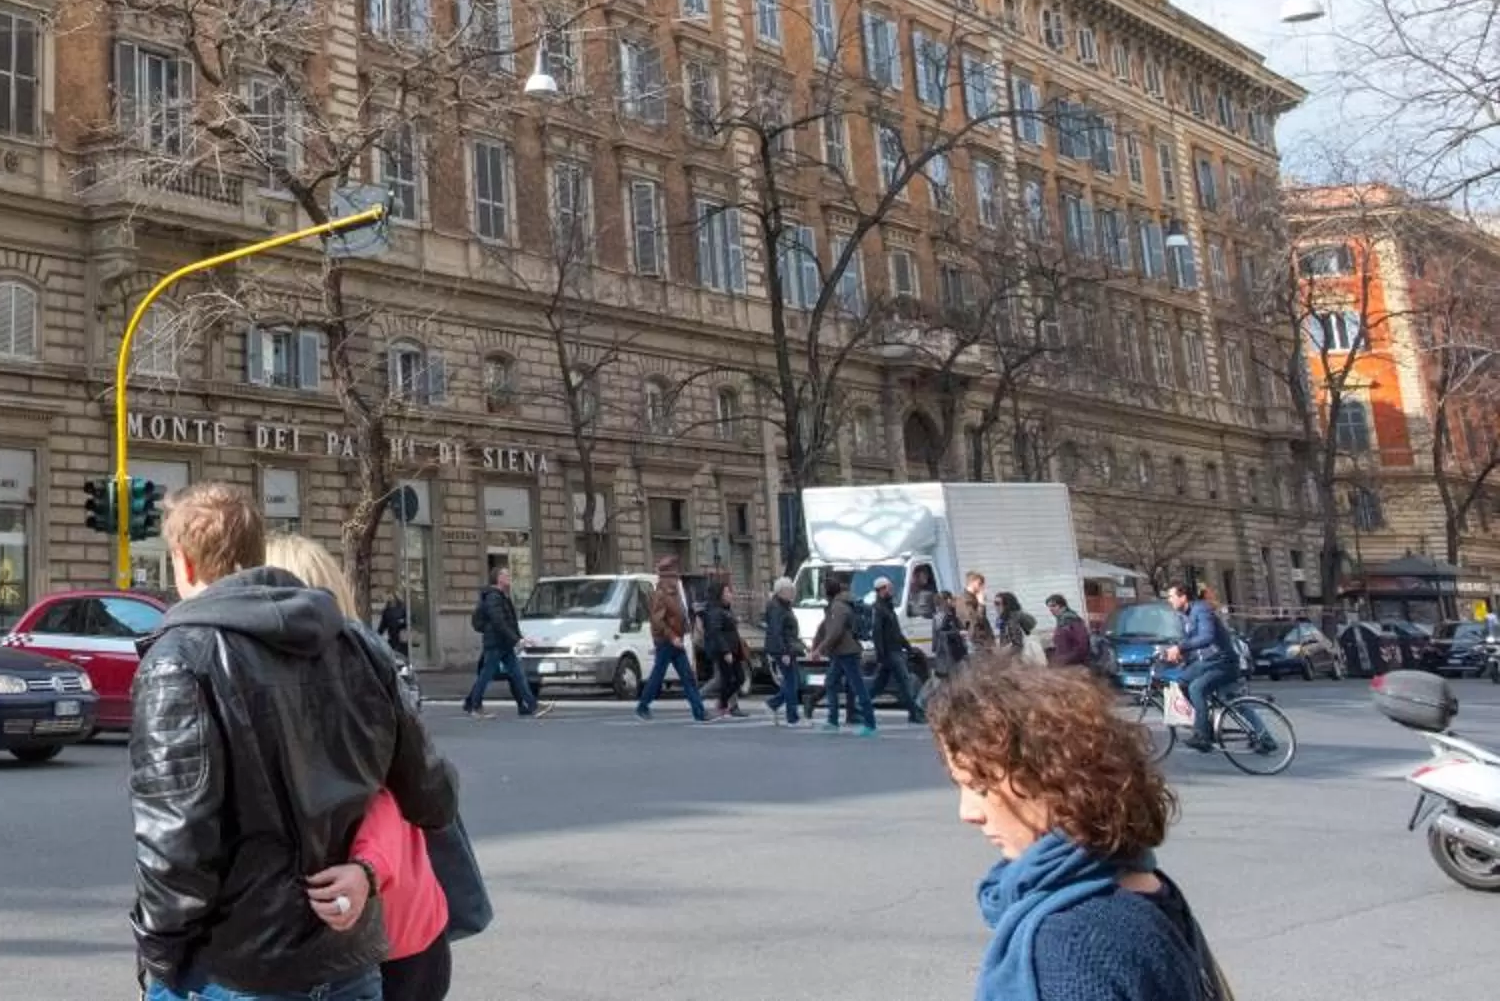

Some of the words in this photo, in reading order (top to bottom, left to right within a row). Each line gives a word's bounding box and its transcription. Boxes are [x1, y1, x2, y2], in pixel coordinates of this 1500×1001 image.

[127, 413, 229, 446] MONTE
[256, 423, 300, 452] DEI
[326, 430, 416, 463] PAHI
[437, 441, 461, 467] DI
[483, 447, 549, 474] SIENA
